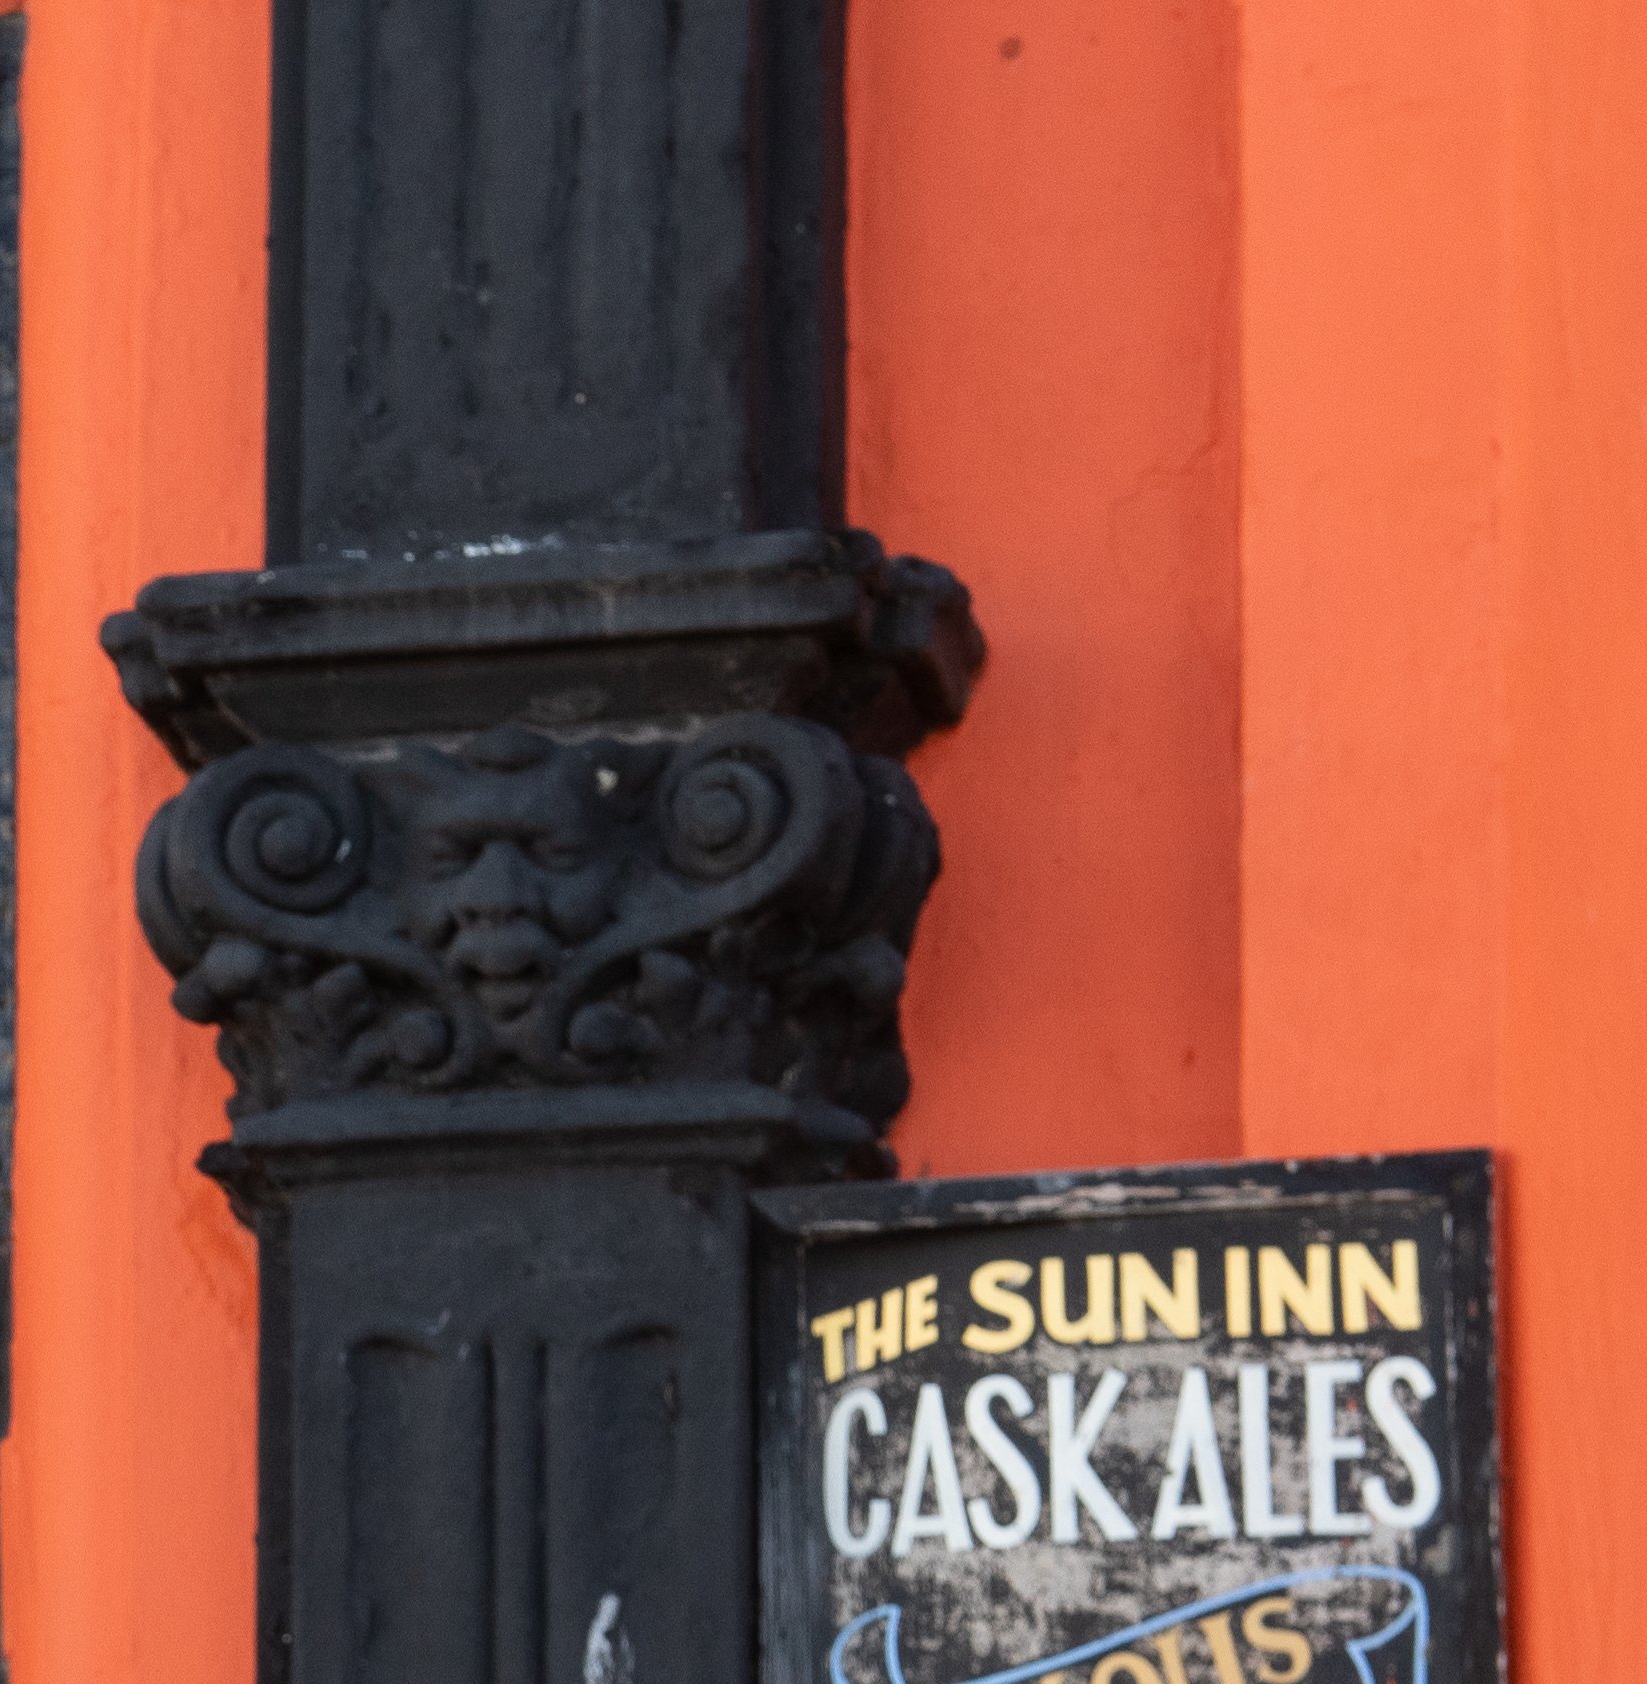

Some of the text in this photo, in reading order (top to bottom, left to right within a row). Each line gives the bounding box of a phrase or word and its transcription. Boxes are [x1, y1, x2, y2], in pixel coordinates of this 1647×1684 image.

[811, 1239, 1423, 1383] THE SUN INN
[822, 1355, 1442, 1559] CASK ALES
